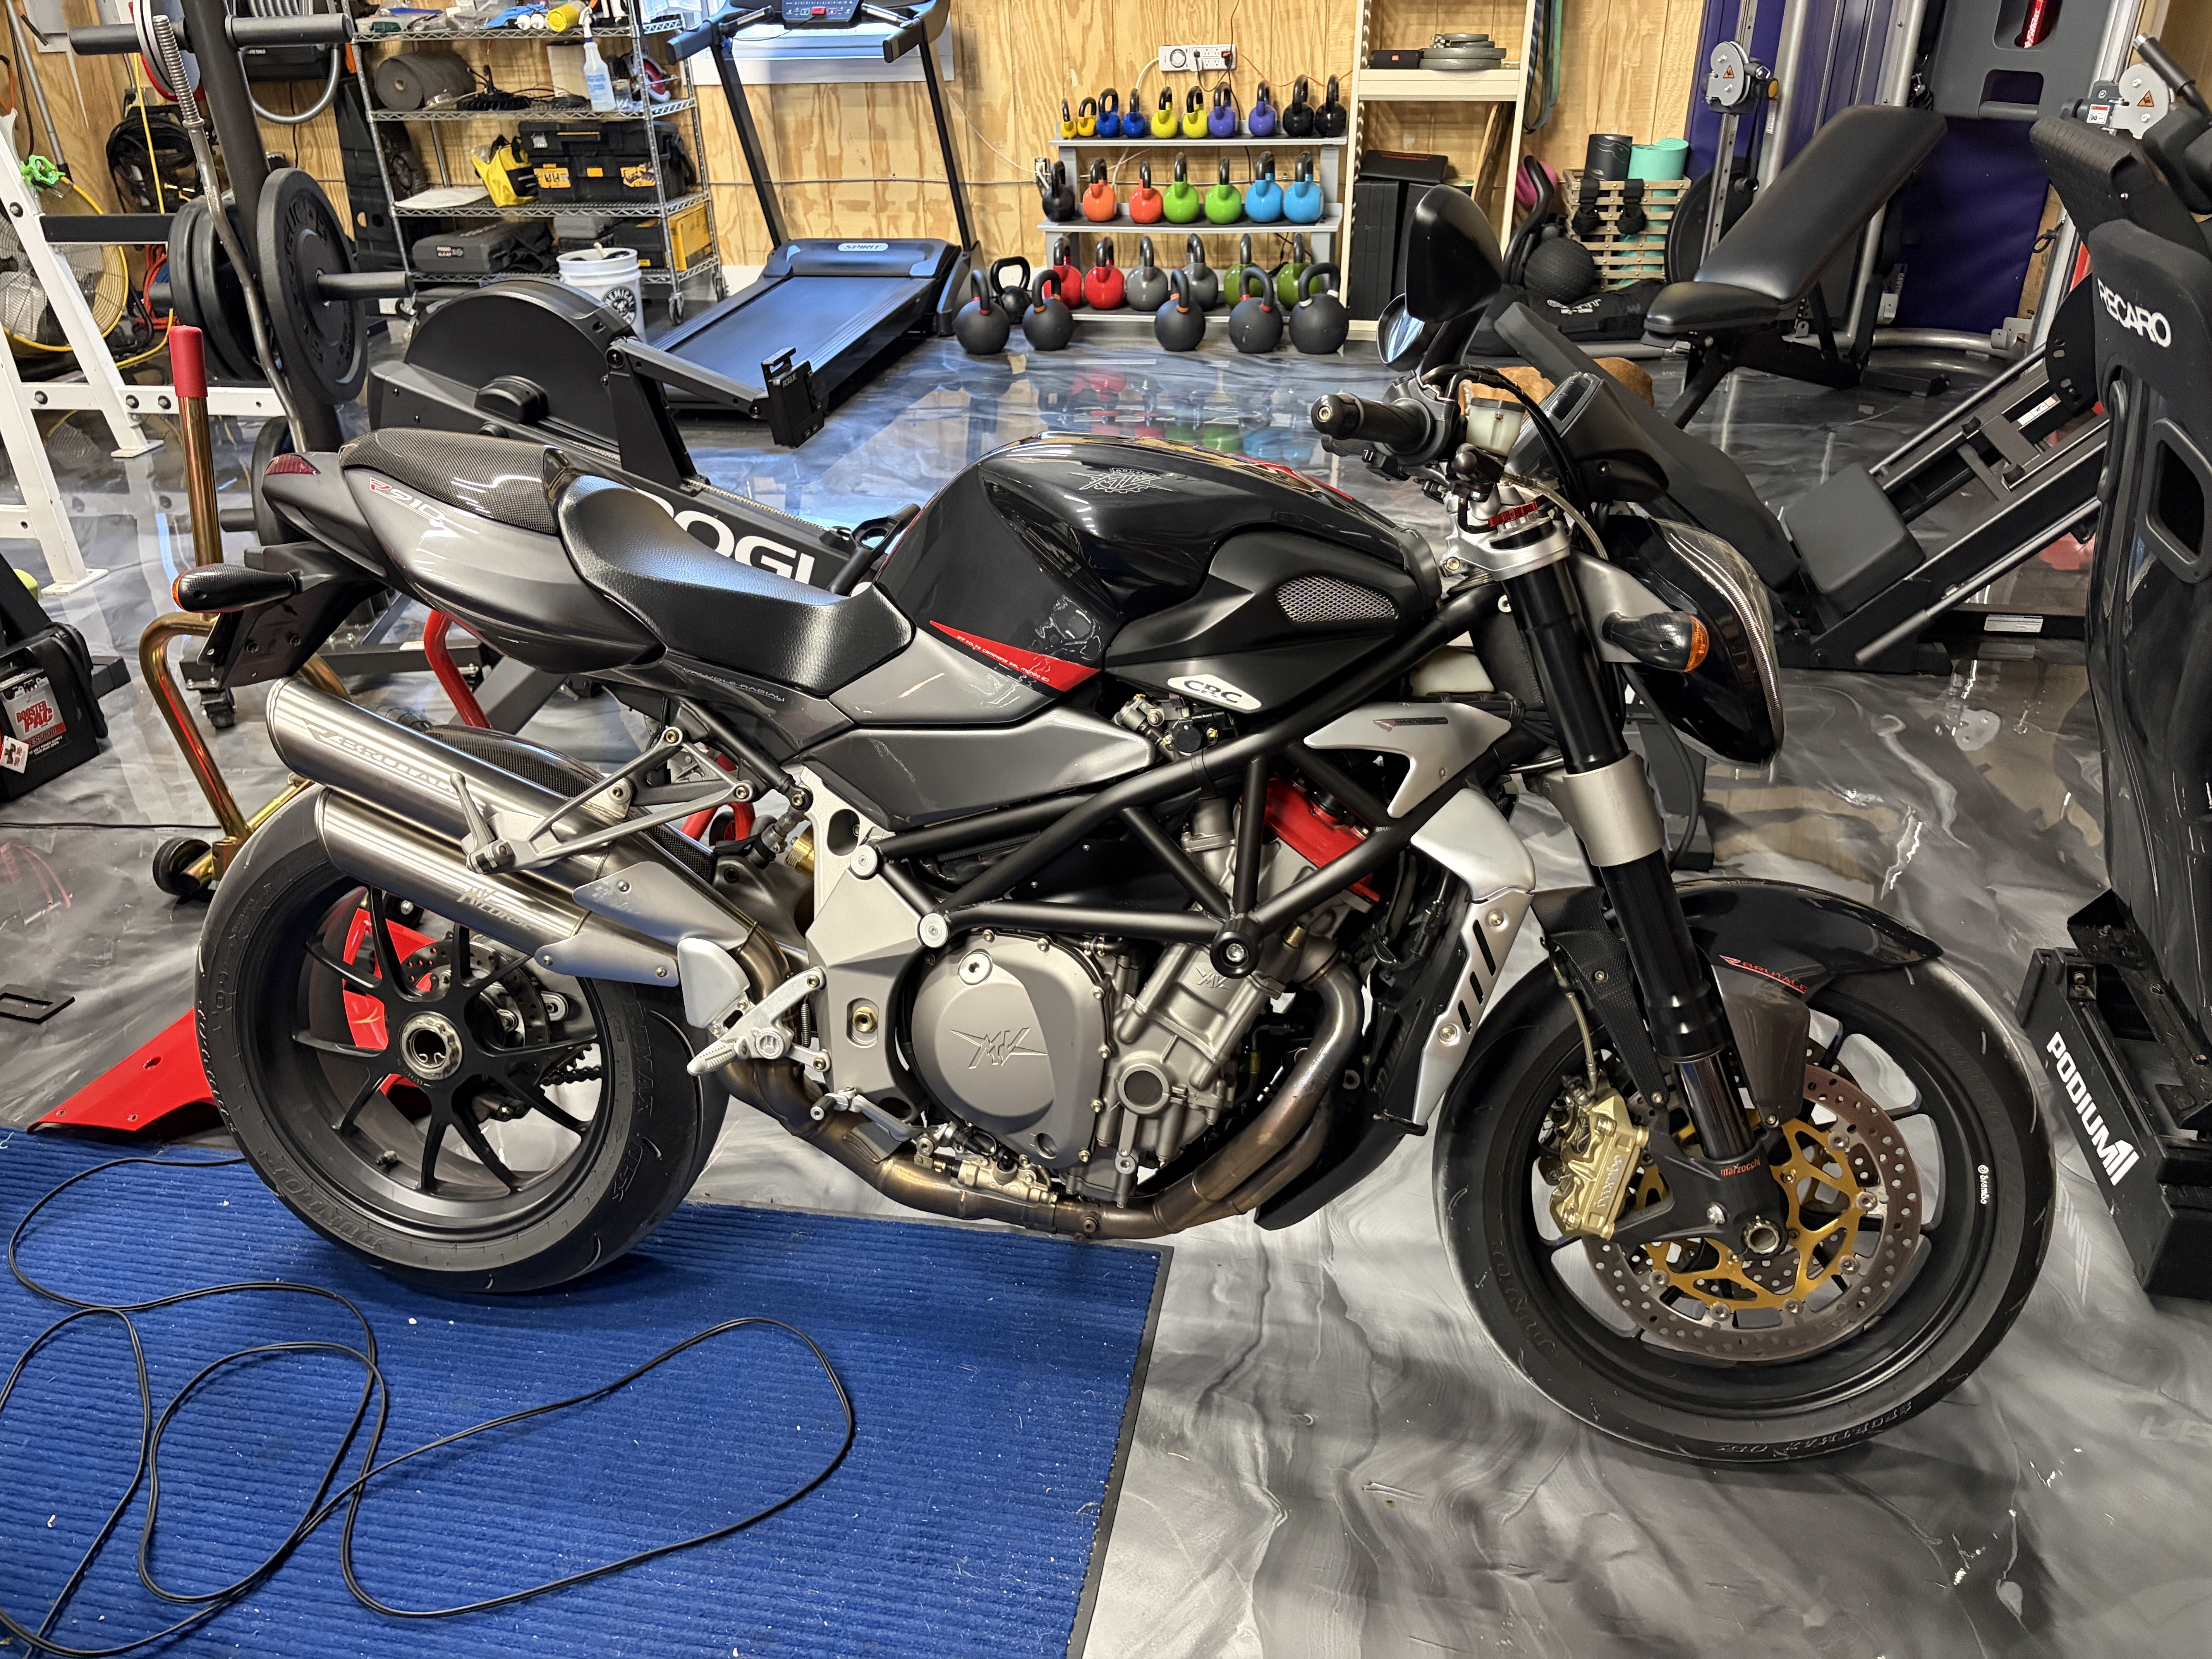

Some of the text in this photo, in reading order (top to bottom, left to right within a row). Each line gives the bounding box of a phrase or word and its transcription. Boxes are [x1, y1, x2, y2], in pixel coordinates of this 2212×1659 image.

[604, 289, 635, 307] HEMICAL
[2097, 277, 2171, 348] RECARO
[16, 700, 47, 723] BOOSTER
[24, 708, 53, 733] PAC
[338, 736, 455, 794] BRUTAL
[1742, 962, 1808, 992] BRUTALE
[1593, 1154, 1624, 1207] brembo
[1980, 1175, 1989, 1204] brembo
